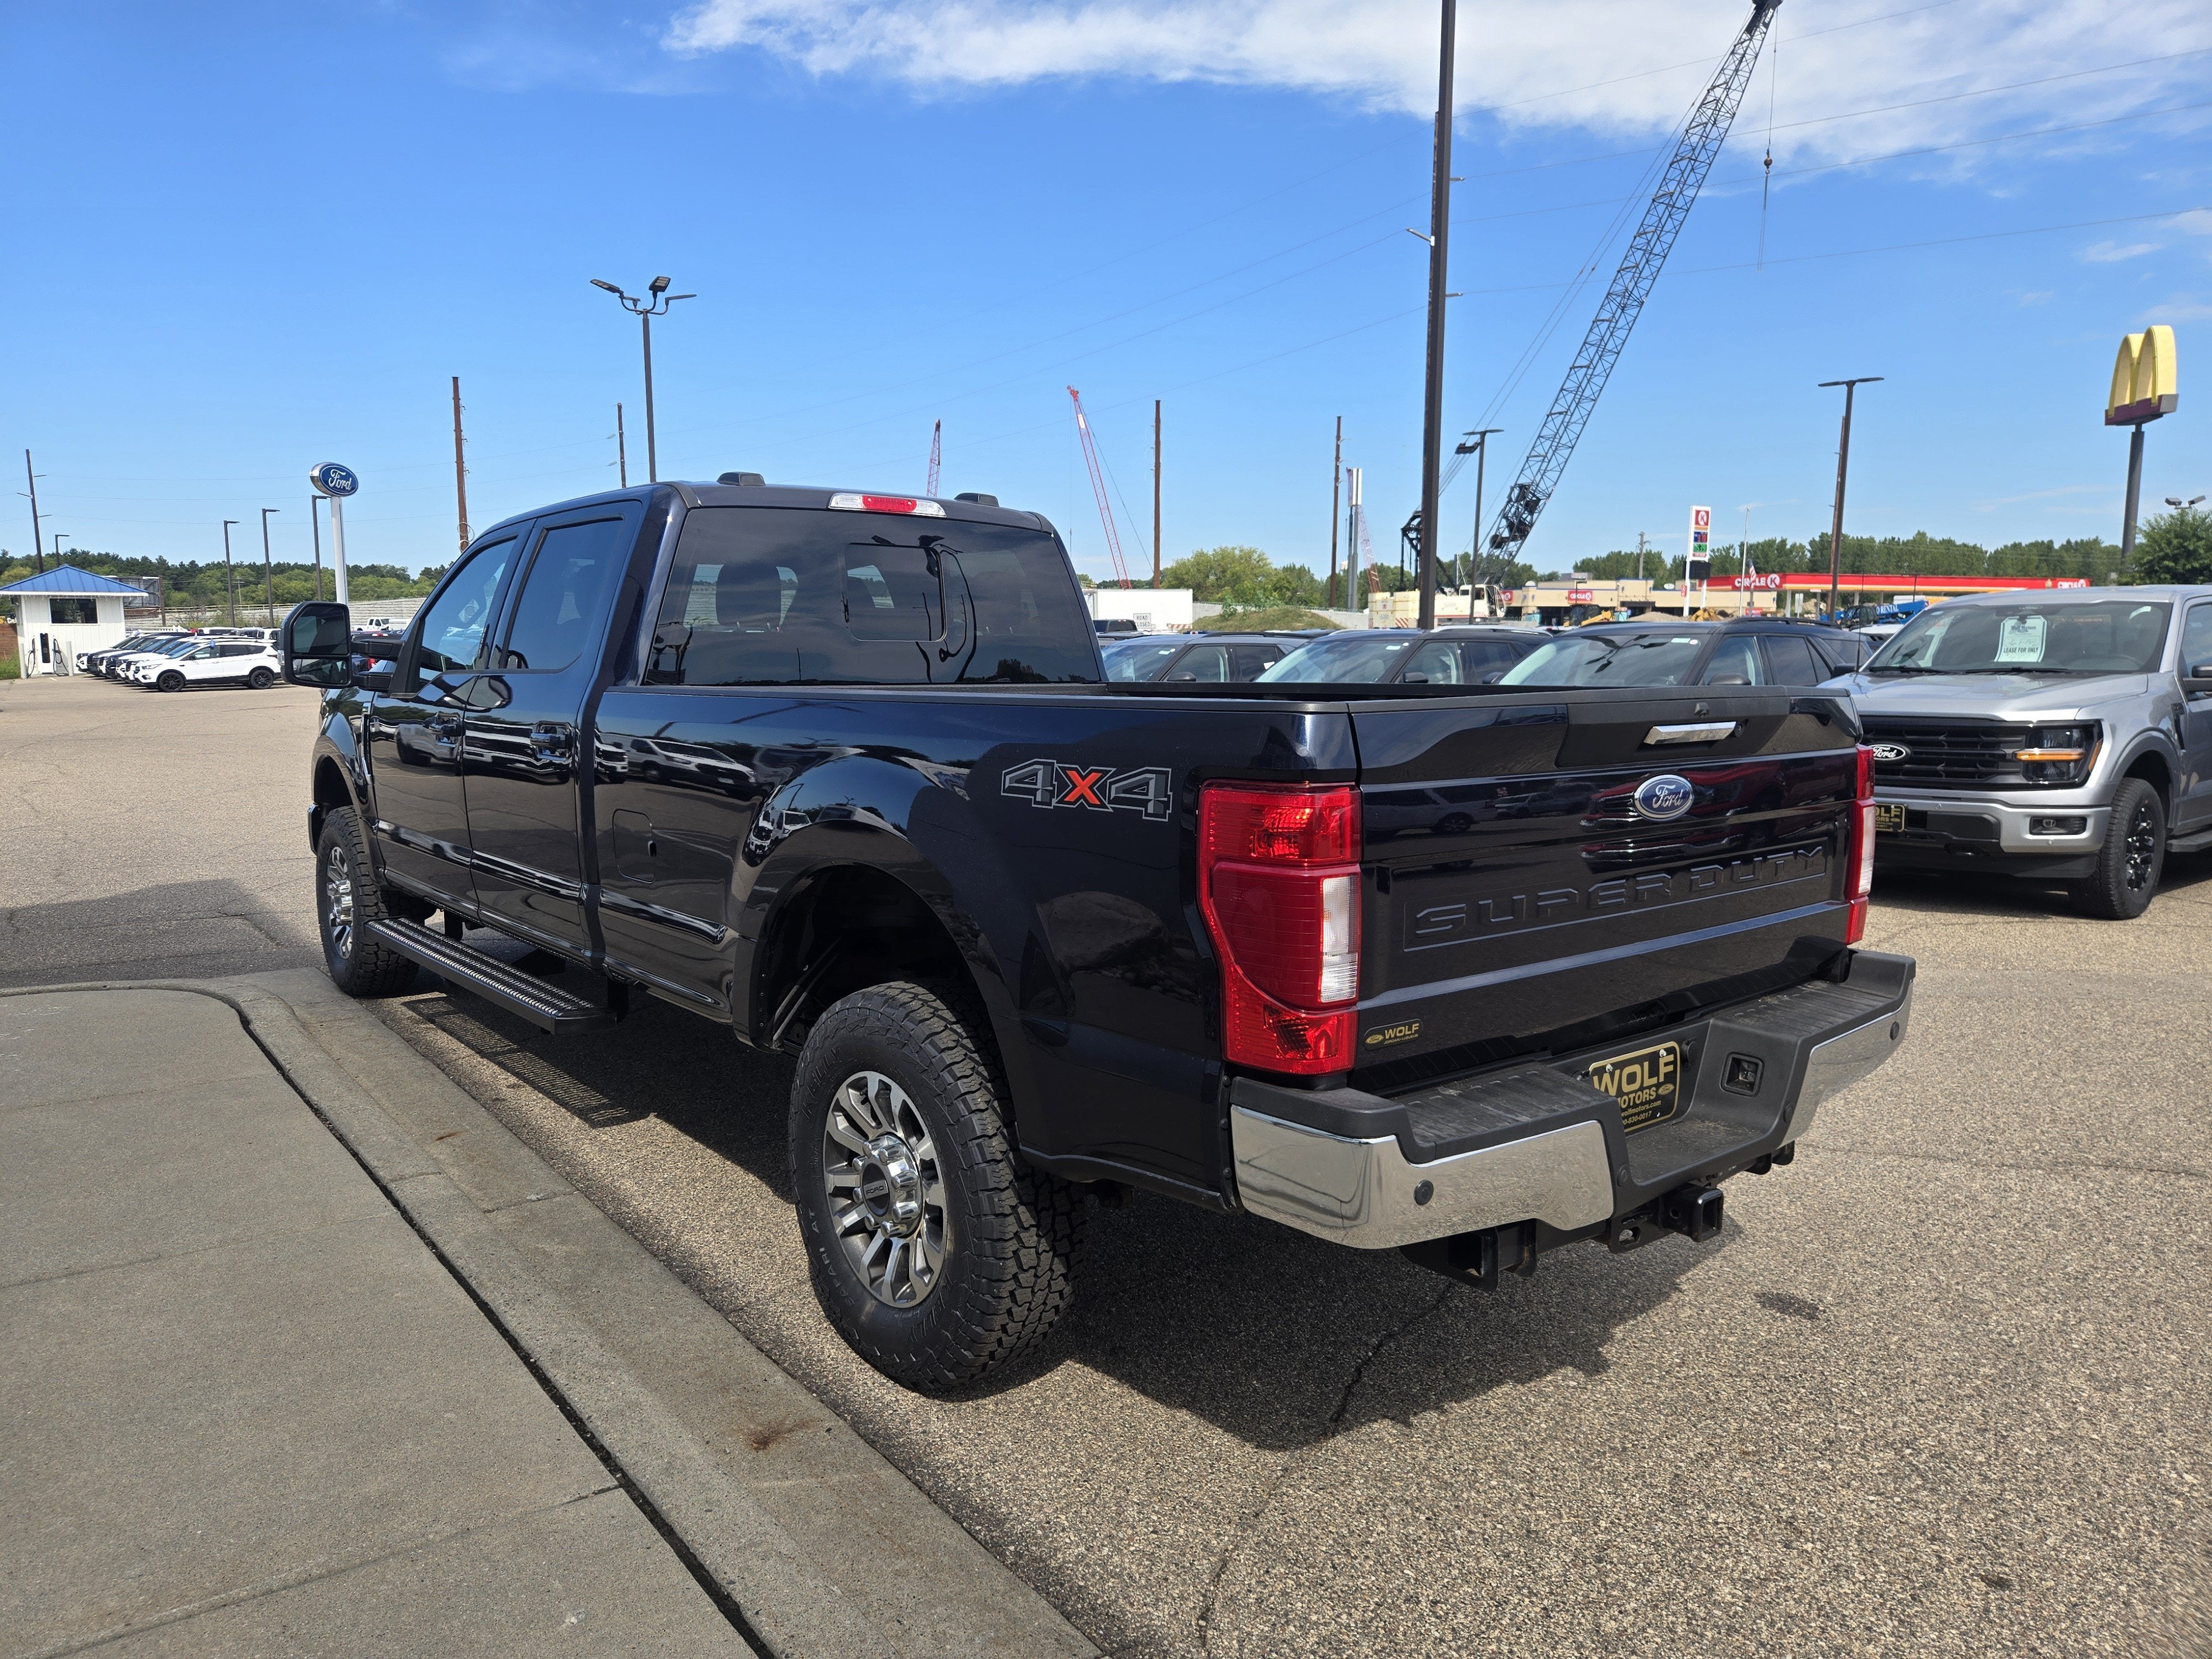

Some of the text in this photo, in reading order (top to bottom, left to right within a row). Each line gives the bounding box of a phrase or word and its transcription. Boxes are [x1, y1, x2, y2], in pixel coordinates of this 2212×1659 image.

[328, 469, 352, 491] Ford
[1735, 577, 1766, 587] CRLE
[1881, 604, 1899, 613] RENTAL
[1872, 747, 1897, 758] Ford
[1652, 784, 1683, 808] Ford
[1416, 846, 1822, 938] SUPER DUTY
[1385, 1023, 1420, 1039] WOLF
[1593, 1053, 1674, 1096] WOLF
[866, 1185, 884, 1194] FORD
[820, 1246, 855, 1307] SAFARI
